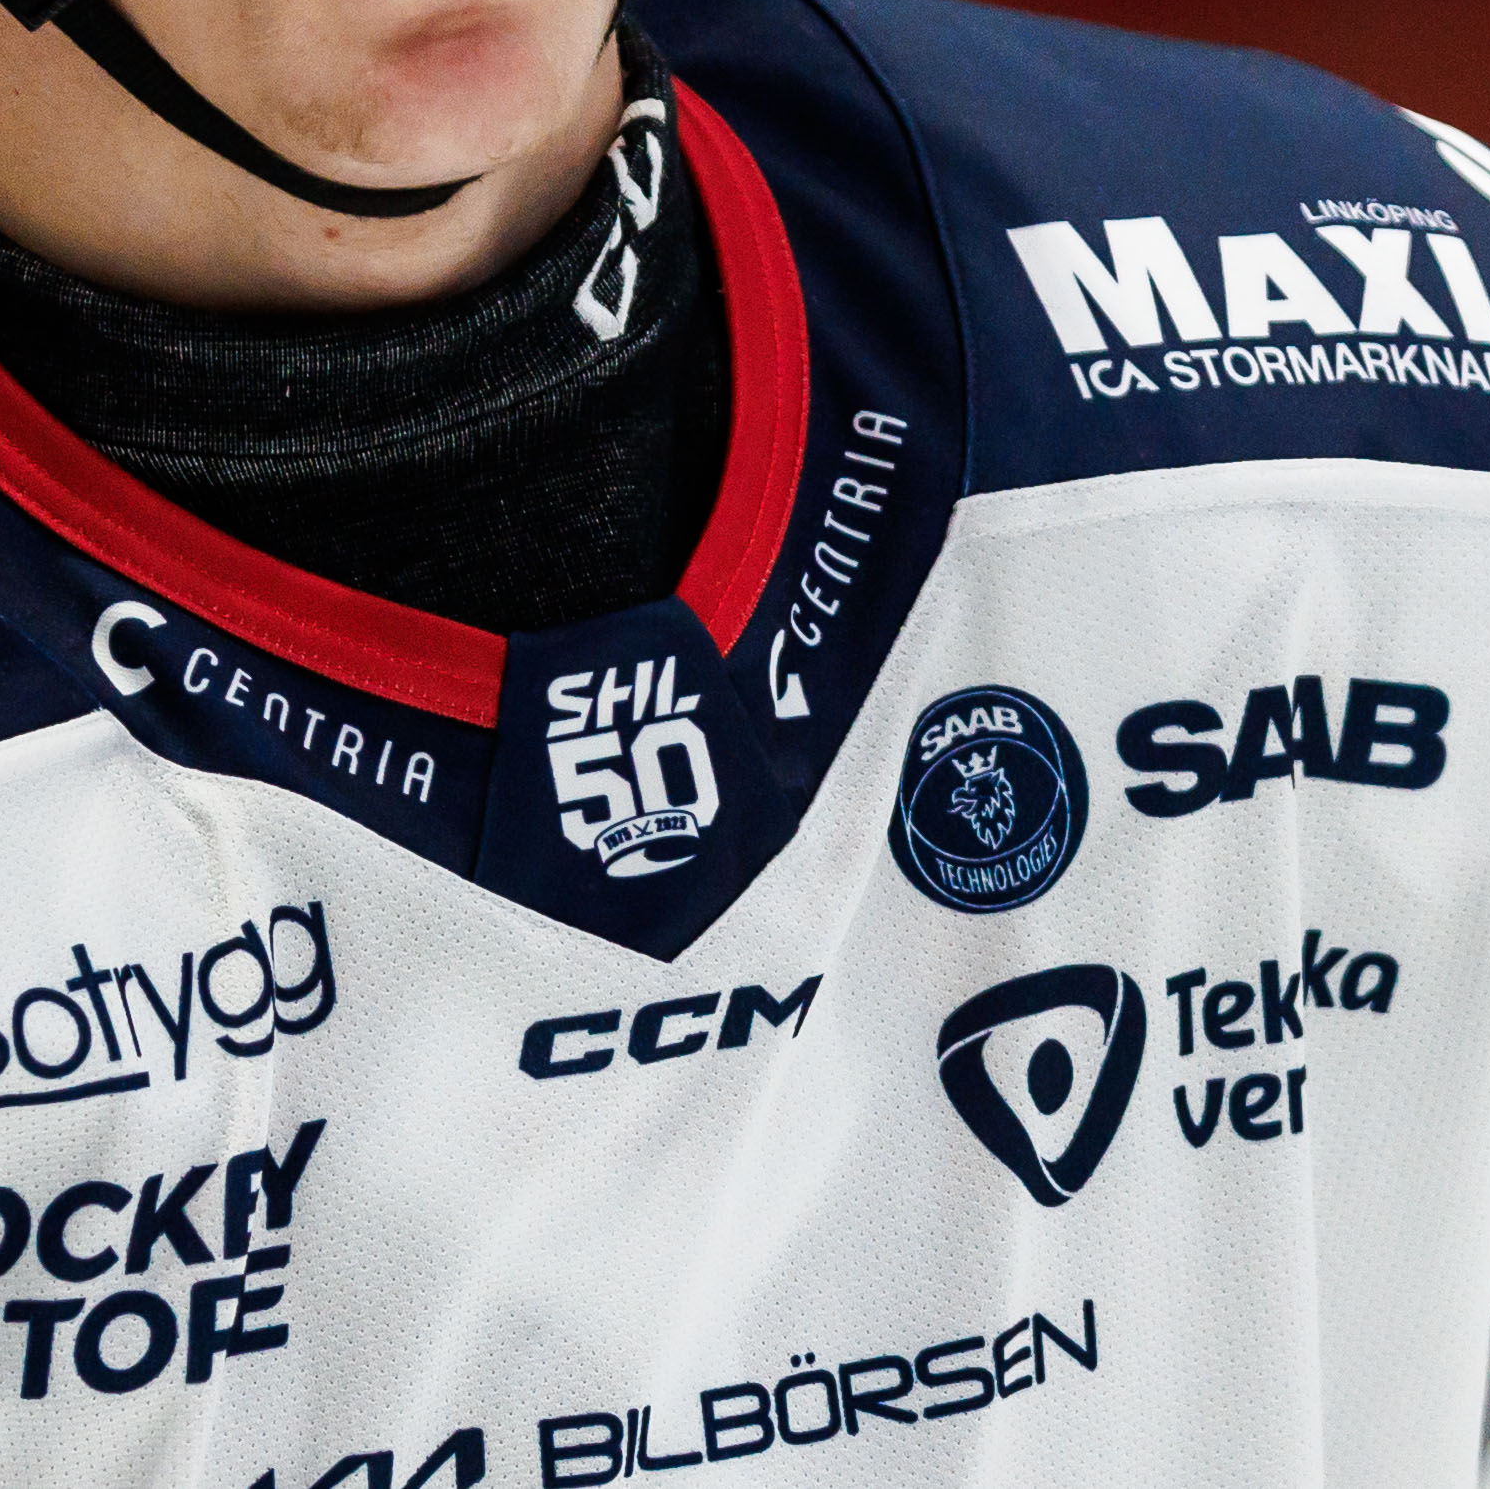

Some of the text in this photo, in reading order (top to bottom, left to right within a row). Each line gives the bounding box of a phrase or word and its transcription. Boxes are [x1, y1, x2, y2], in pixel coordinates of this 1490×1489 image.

[1299, 197, 1460, 232] LINKÖPING
[1070, 358, 1160, 400] ICA
[791, 409, 908, 648] CENTRIA
[183, 647, 436, 805] CENTRIA
[547, 655, 701, 739] SHL
[920, 706, 1023, 761] SAAB
[1116, 674, 1451, 818] SAAB
[547, 717, 720, 850] 50
[936, 825, 1058, 894] TECHNOLOGIES
[519, 973, 824, 1080] CCM
[539, 1299, 1099, 1489] BILBÖRSEN
